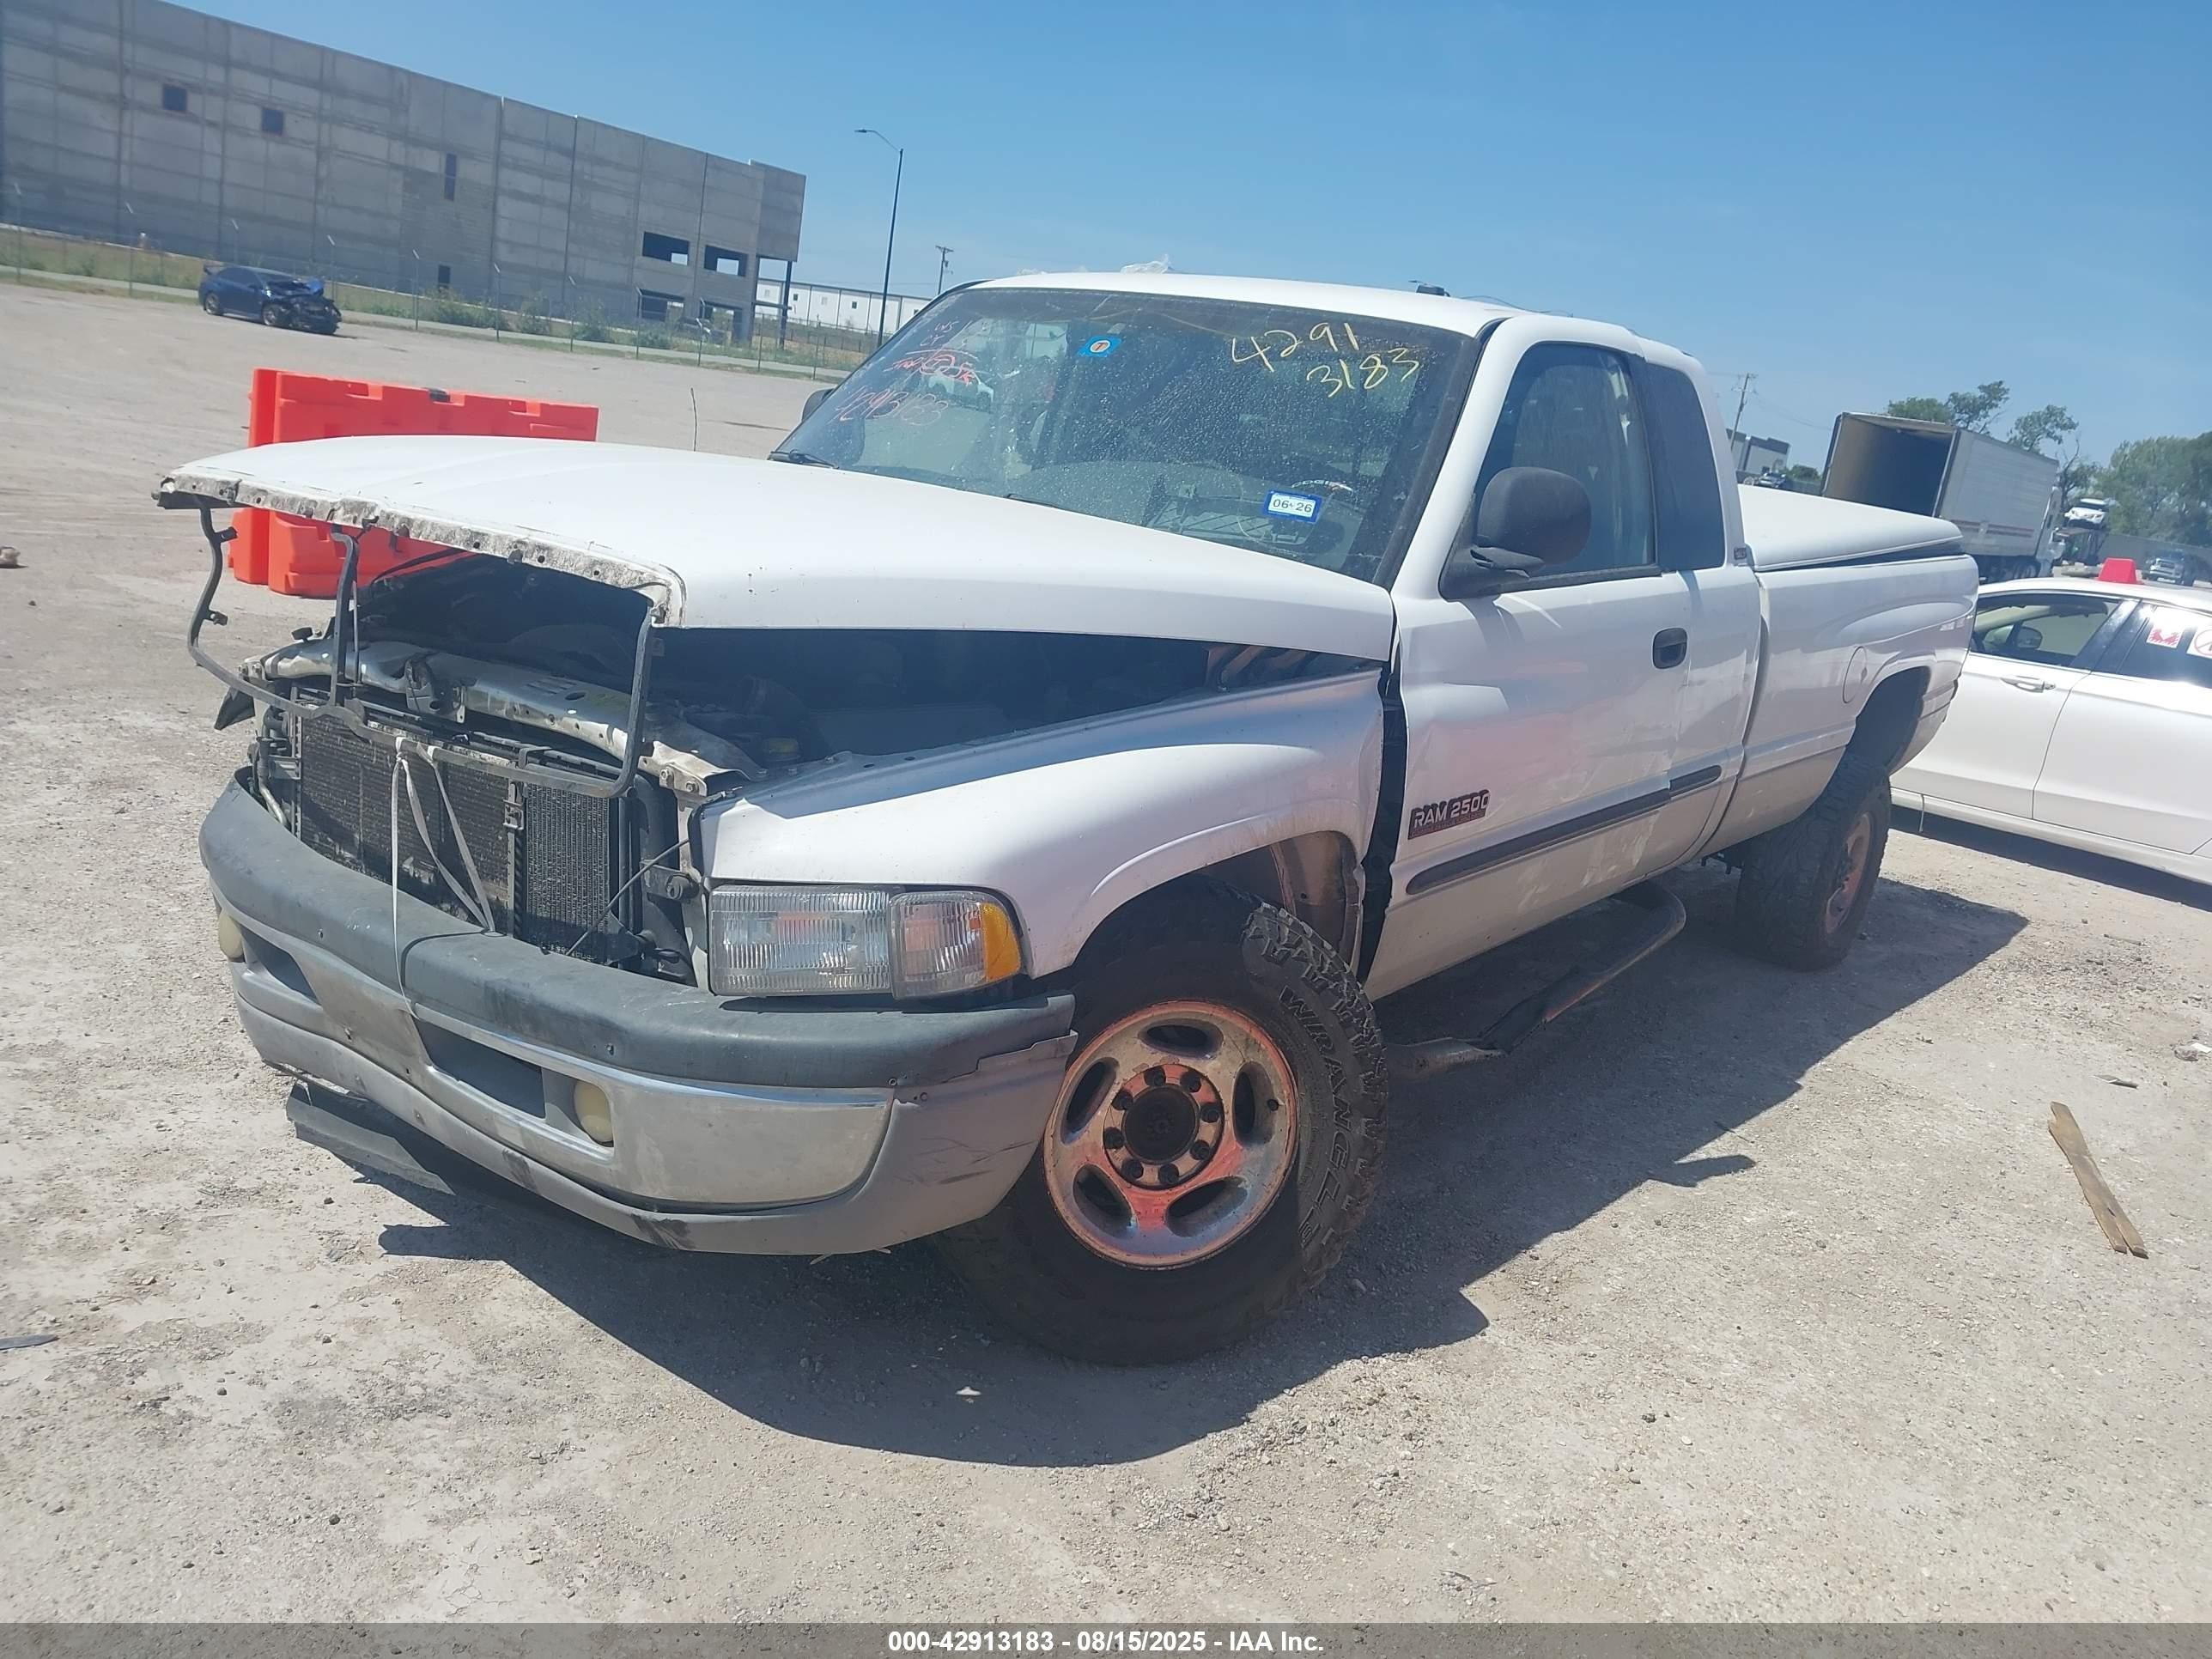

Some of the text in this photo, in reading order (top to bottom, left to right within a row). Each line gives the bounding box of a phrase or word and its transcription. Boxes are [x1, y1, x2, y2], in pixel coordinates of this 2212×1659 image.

[1231, 322, 1360, 373] 4291
[1305, 347, 1420, 398] 3183
[1272, 498, 1313, 514] 06 26
[1413, 792, 1492, 830] RAM 2500
